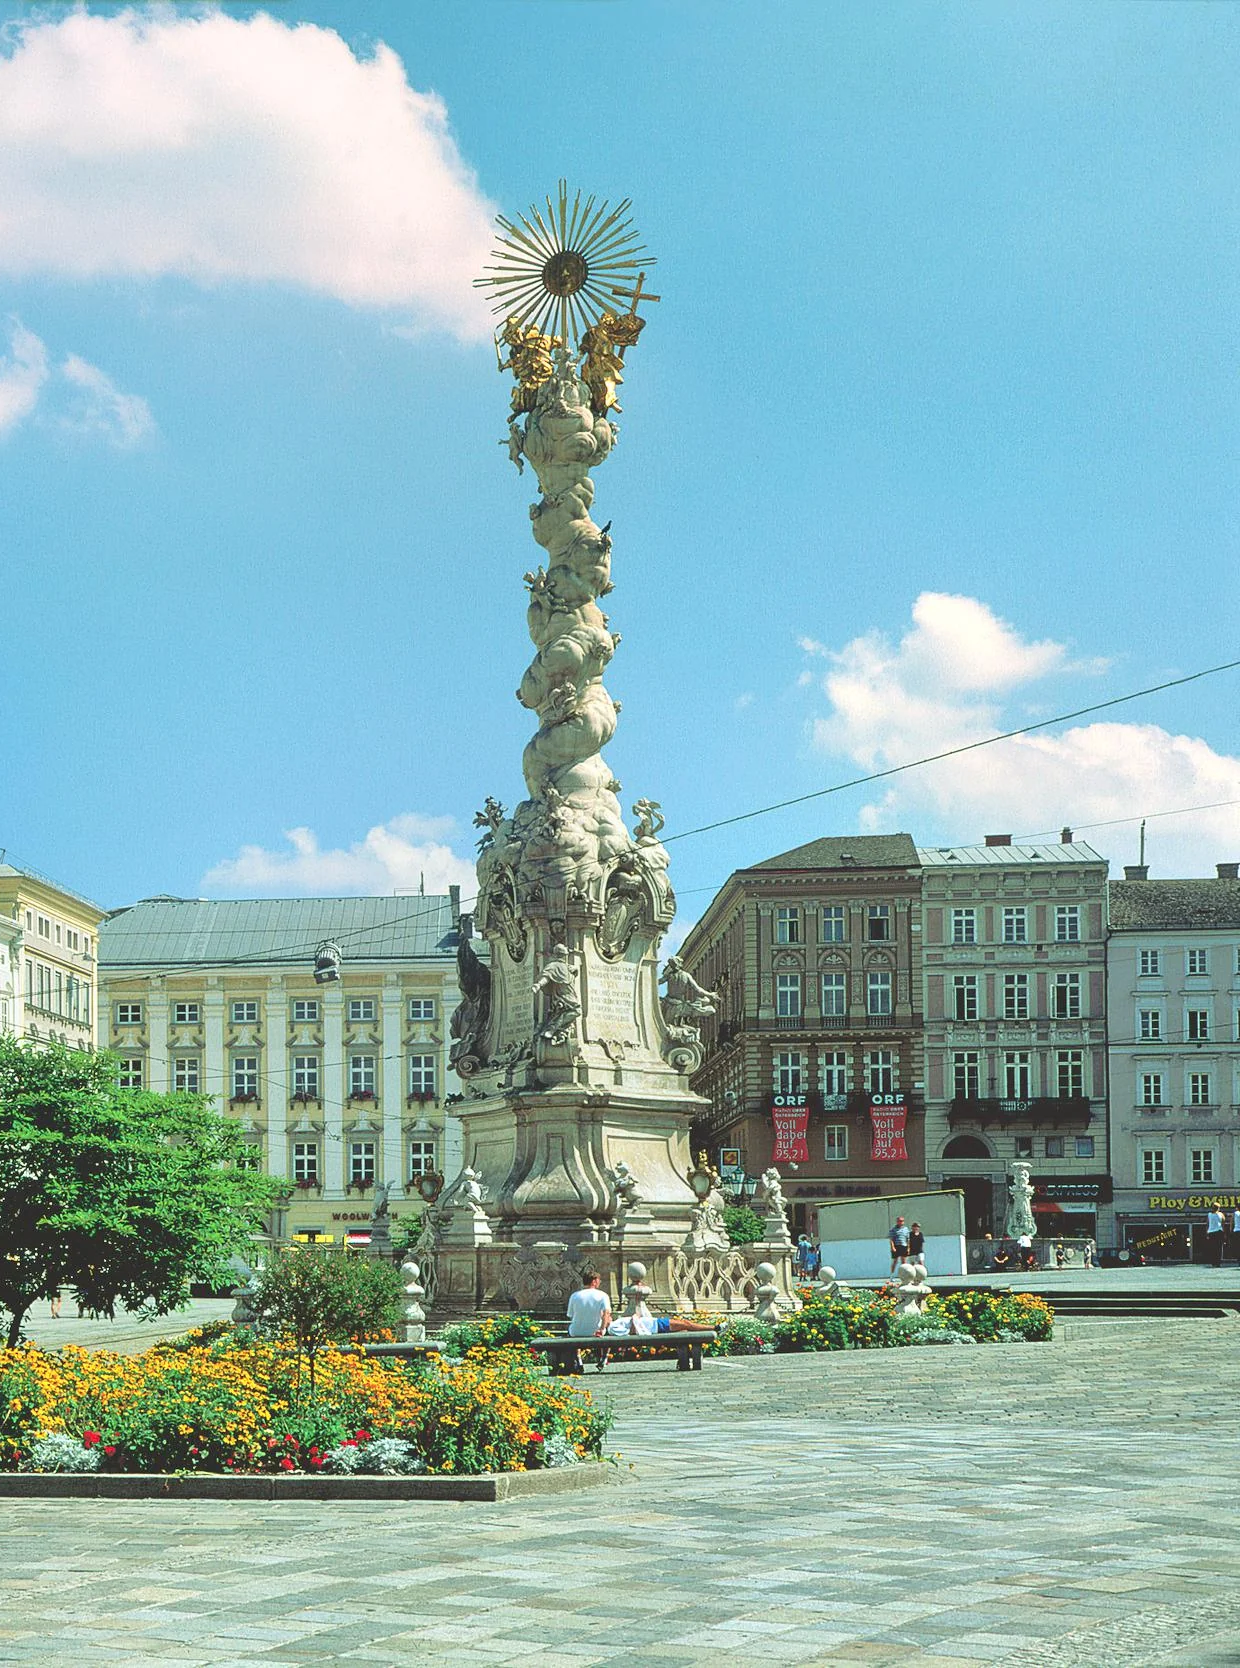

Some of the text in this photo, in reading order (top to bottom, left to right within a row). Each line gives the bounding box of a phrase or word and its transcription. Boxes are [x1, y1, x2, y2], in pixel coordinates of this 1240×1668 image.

[774, 1095, 806, 1106] ORF
[872, 1094, 905, 1104] ORF
[775, 1119, 796, 1129] Voll
[873, 1118, 895, 1129] Voll
[776, 1128, 807, 1140] dabei
[875, 1127, 905, 1139] dabei
[776, 1140, 794, 1149] auf
[875, 1139, 892, 1148] auf
[332, 1212, 398, 1220] WOOLWH
